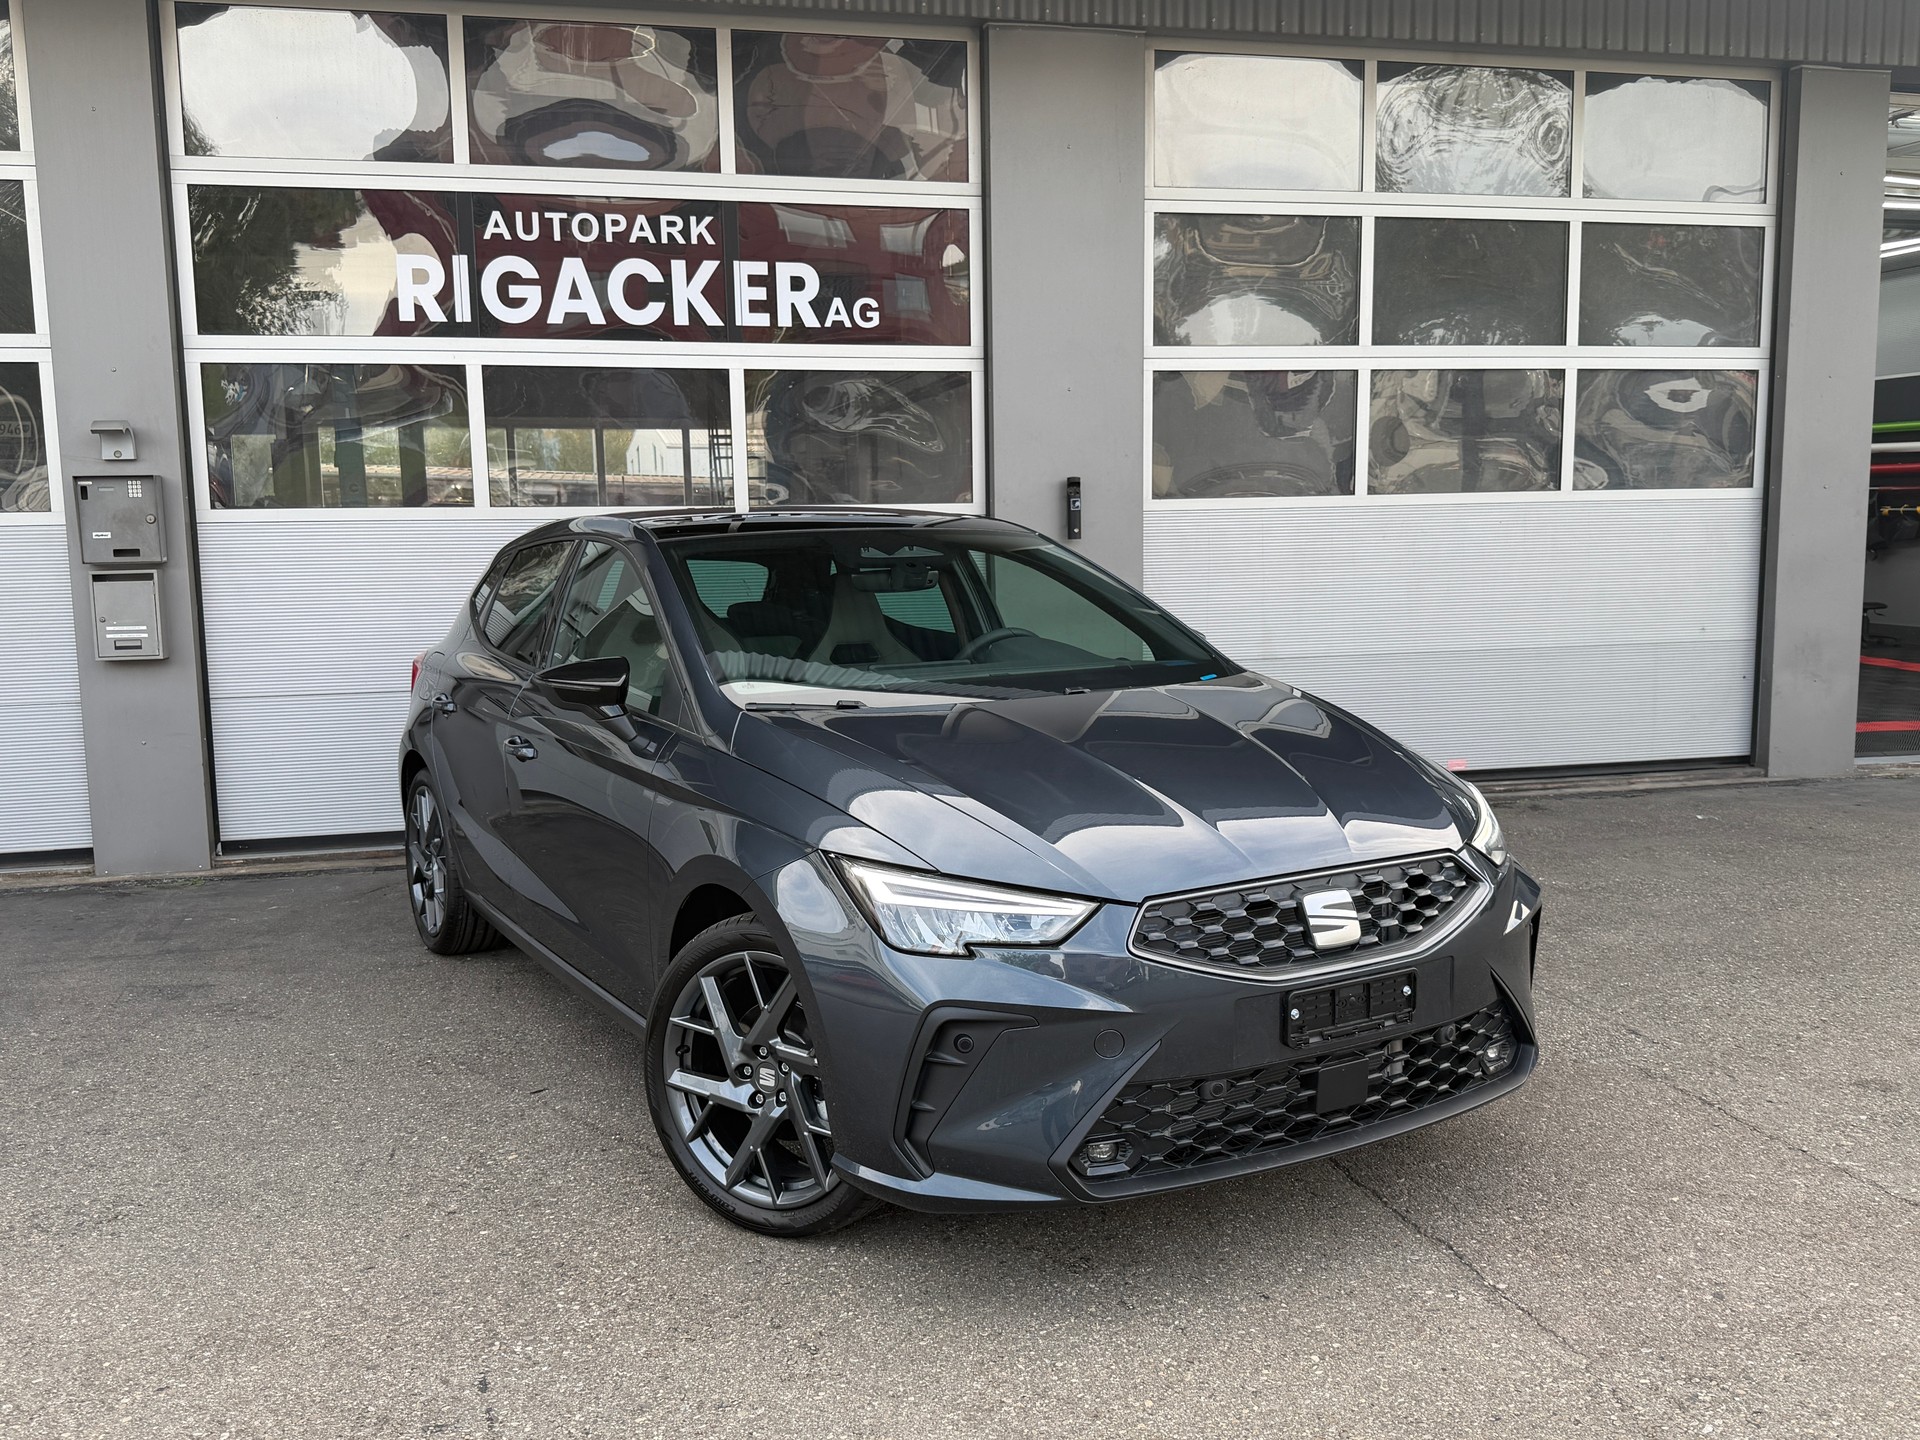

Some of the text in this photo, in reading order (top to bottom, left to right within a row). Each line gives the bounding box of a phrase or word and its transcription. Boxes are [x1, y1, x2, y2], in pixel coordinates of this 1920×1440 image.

[483, 211, 716, 245] AUTOPARK
[398, 254, 880, 328] RIGACKER AG
